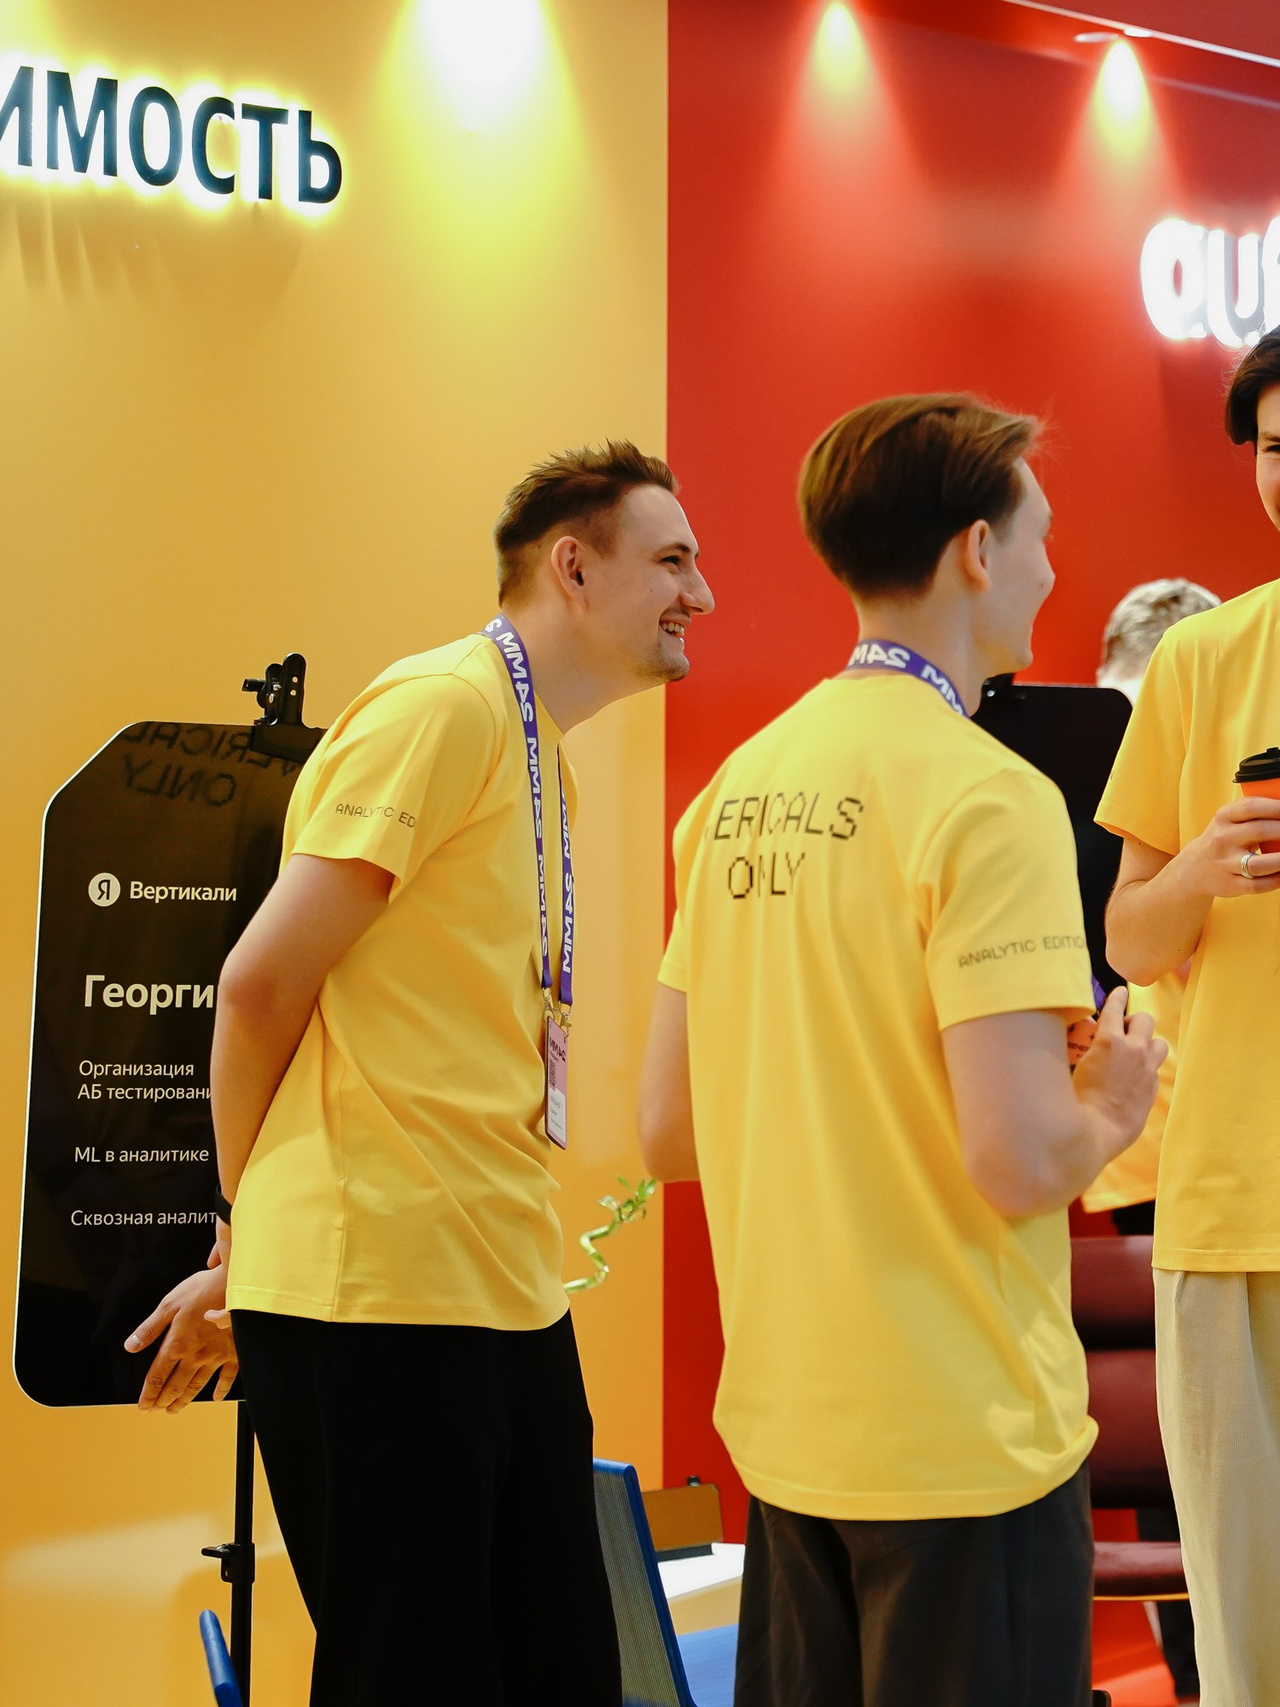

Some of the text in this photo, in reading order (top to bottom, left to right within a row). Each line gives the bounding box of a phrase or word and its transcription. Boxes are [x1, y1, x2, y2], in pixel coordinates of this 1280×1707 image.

[705, 791, 865, 841] ERICALS
[129, 880, 237, 904] Вертикали
[958, 938, 1037, 969] ANALYTIC
[84, 974, 214, 1016] Георги
[78, 1059, 195, 1079] Организация
[77, 1083, 102, 1100] АБ
[74, 1146, 210, 1163] ML в аналитике
[70, 1209, 153, 1226] Сквозная
